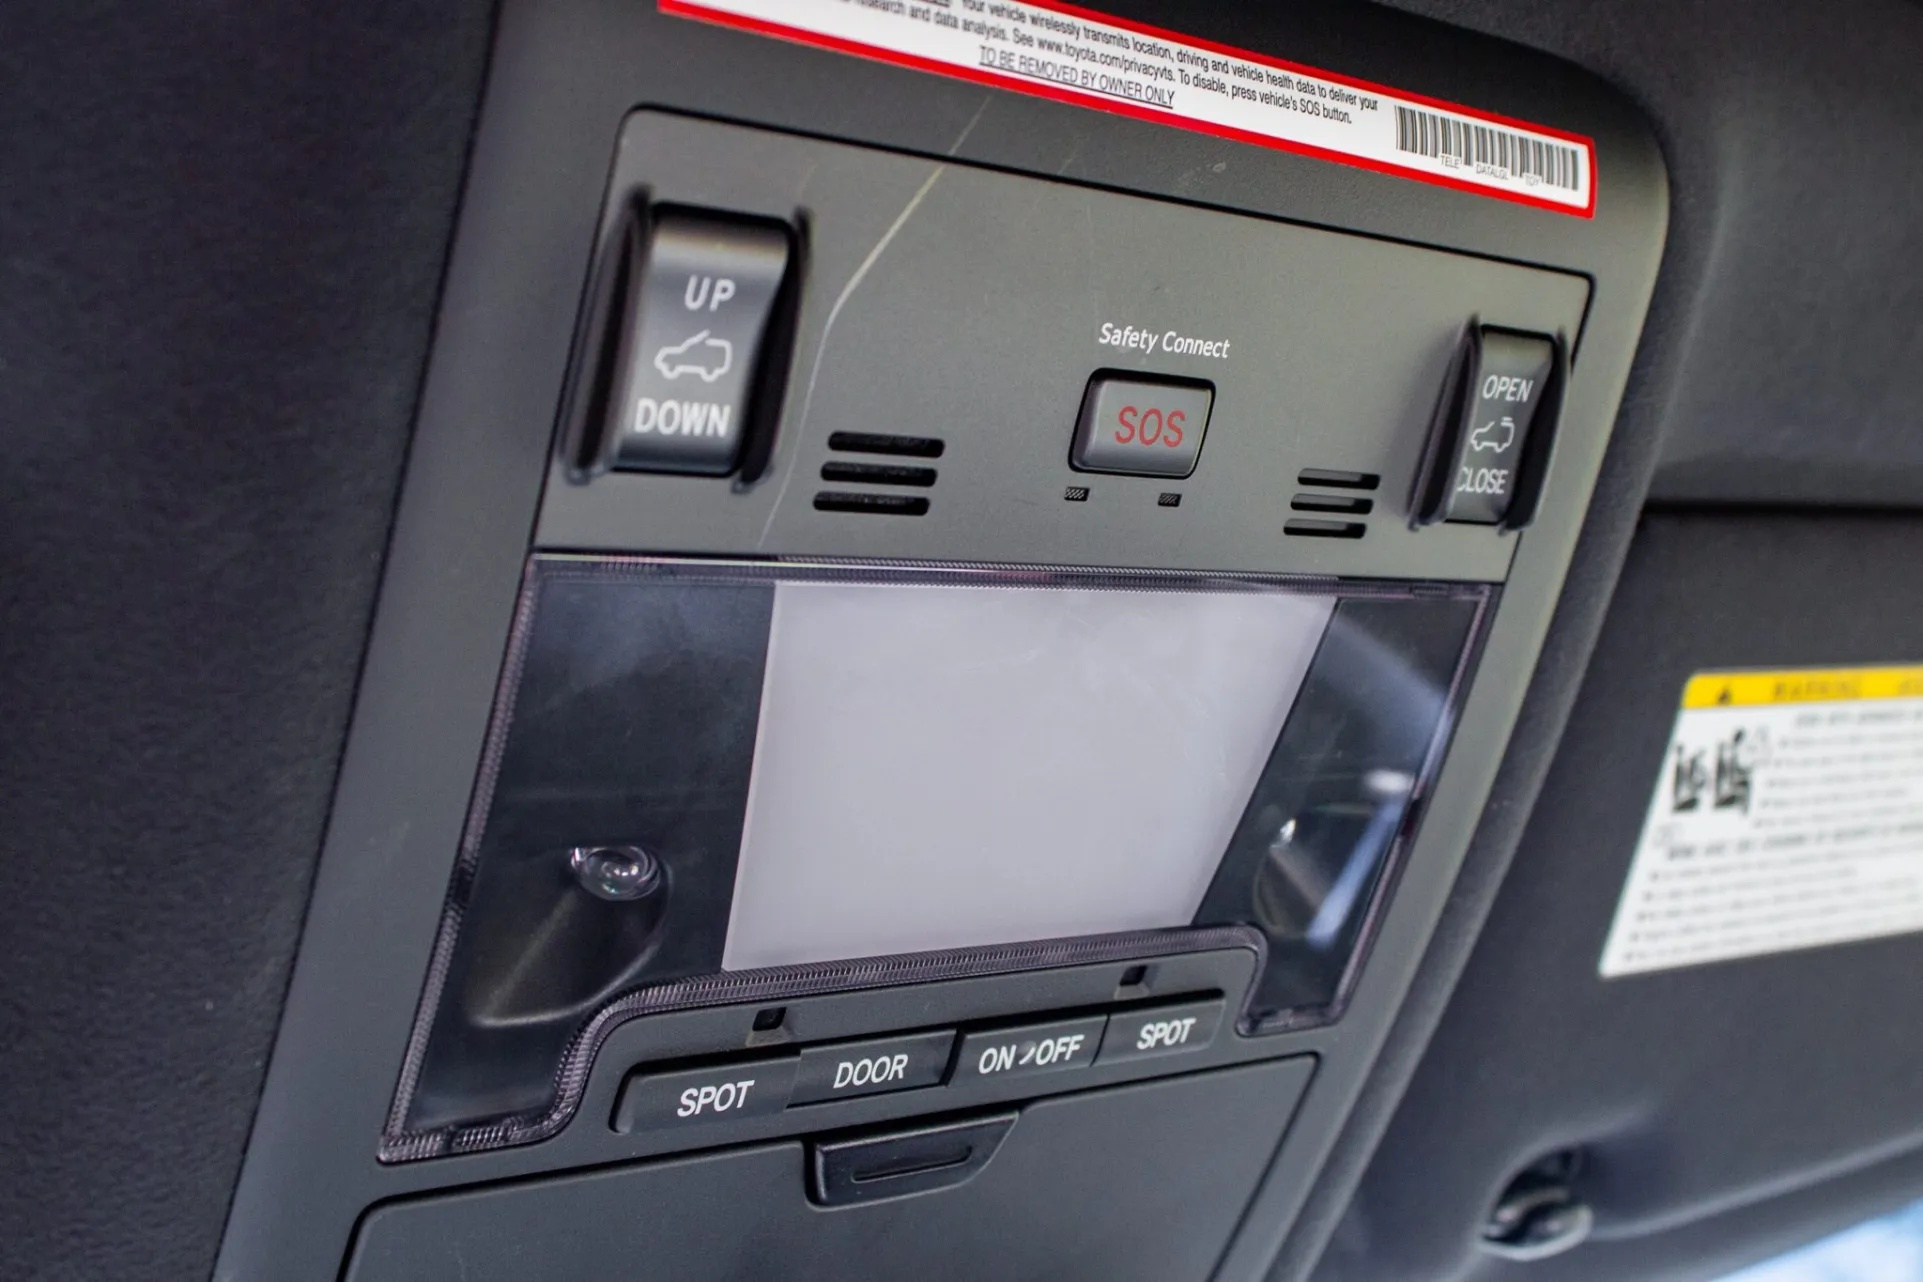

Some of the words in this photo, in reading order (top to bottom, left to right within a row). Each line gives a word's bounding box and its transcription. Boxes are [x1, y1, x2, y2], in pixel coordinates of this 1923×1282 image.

[909, 4, 930, 22] and
[933, 10, 959, 29] data
[962, 18, 1009, 41] analysis.
[1012, 28, 1034, 47] See
[1178, 68, 1190, 85] To
[1193, 74, 1228, 97] disable,
[1231, 85, 1257, 101] press
[1259, 91, 1297, 111] vehicle's
[1300, 98, 1320, 116] SOS
[1323, 103, 1352, 124] button.
[979, 45, 996, 64] TO
[1000, 47, 1016, 70] BE
[1019, 54, 1078, 83] REMOVED
[1081, 69, 1098, 88] BY
[1099, 74, 1142, 98] OWNER
[1145, 85, 1176, 106] ONLY
[989, 3, 1026, 23] vehicle
[1029, 12, 1080, 40] wirelessly
[1083, 26, 1130, 49] transmits
[1132, 37, 1174, 62] location,
[1177, 50, 1209, 72] driving
[1211, 59, 1229, 74] and
[1231, 64, 1263, 82] vehicle
[1266, 70, 1294, 90] health
[1296, 79, 1316, 95] data
[1318, 85, 1327, 98] to
[1329, 87, 1357, 106] deliver
[1359, 96, 1378, 111] your
[684, 275, 736, 311] UP
[1099, 322, 1158, 354] Safety
[1162, 331, 1230, 359] Connect
[1482, 374, 1534, 403] OPEN
[634, 397, 731, 437] DOWN
[1115, 406, 1186, 448] SOS
[1136, 1017, 1196, 1050] SPOT
[832, 1054, 909, 1089] DOOR
[677, 1080, 755, 1117] SPOT
